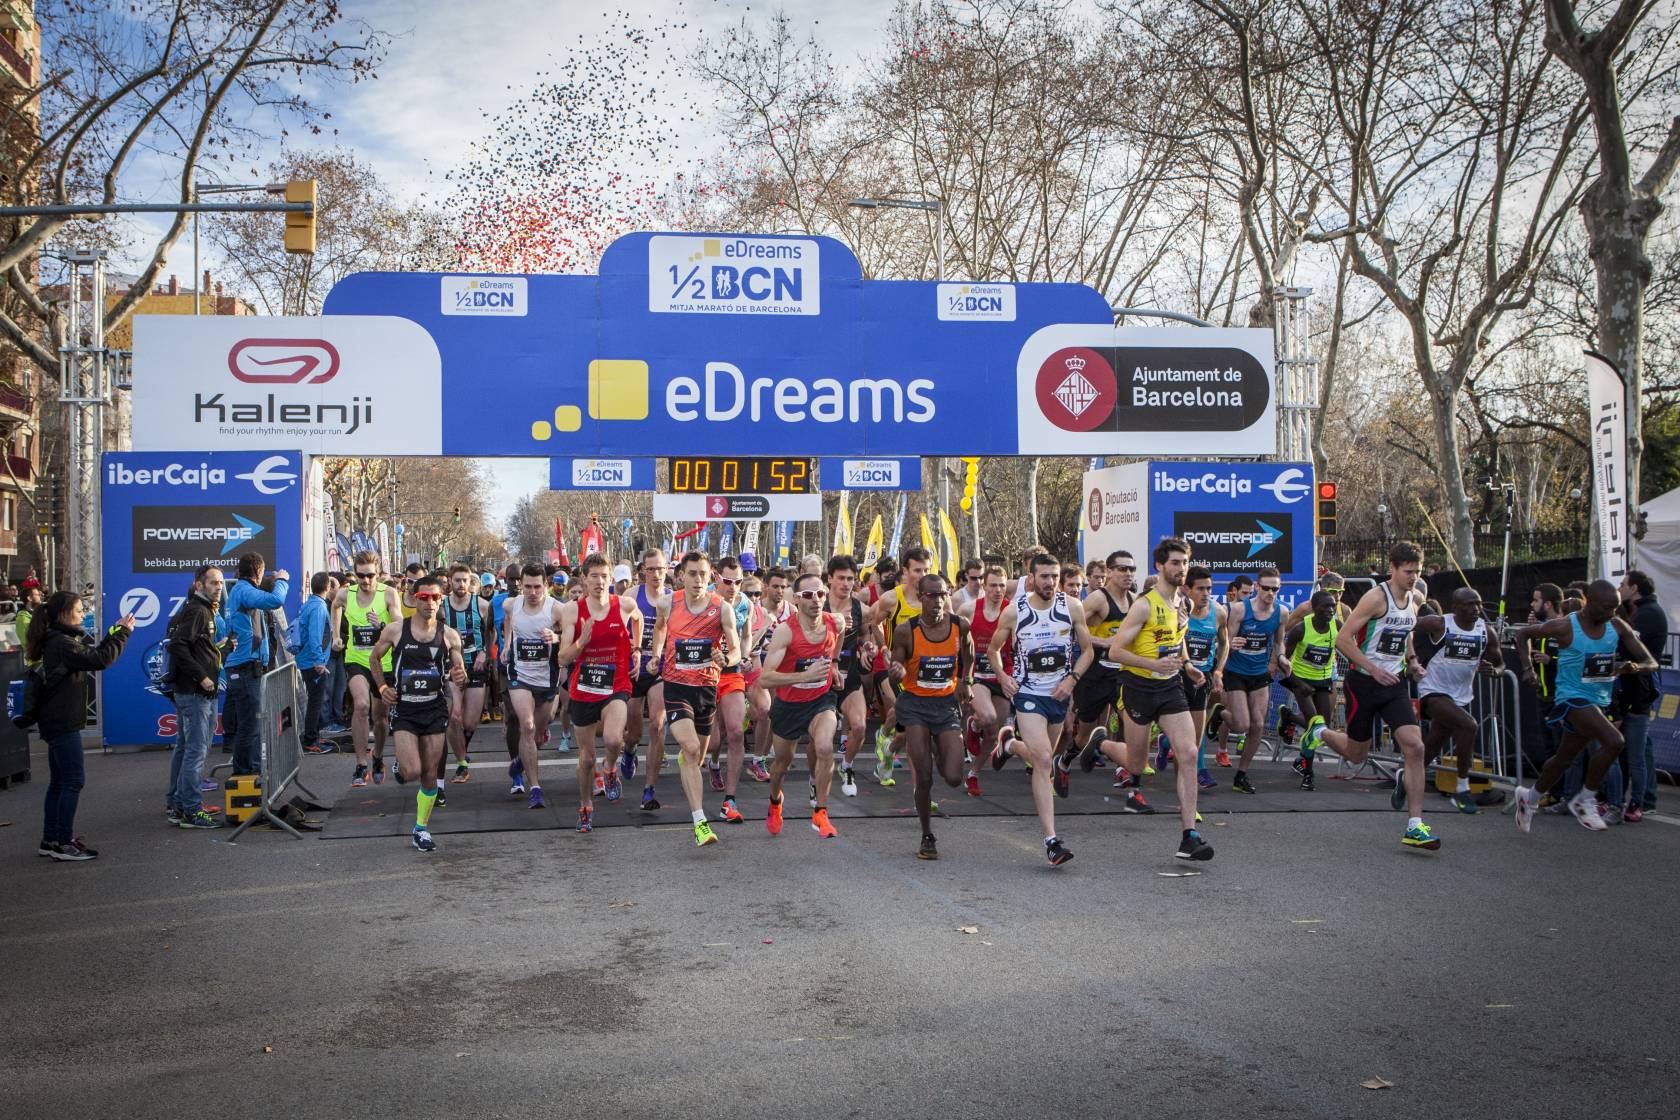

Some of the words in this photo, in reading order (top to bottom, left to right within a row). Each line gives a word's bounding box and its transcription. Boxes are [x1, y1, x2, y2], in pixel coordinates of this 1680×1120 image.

[724, 240, 802, 259] eDreams
[479, 280, 514, 289] eDreams
[711, 265, 803, 302] BCN
[970, 286, 1002, 294] eDreams
[473, 291, 514, 308] BCN
[965, 296, 1002, 312] BCN
[669, 304, 695, 312] MITJA
[696, 304, 734, 312] MARATÓ
[735, 305, 748, 313] DE
[750, 306, 802, 314] BARCELONA
[1132, 366, 1220, 385] Ajuntament
[1223, 367, 1242, 382] de
[665, 361, 936, 423] eDreams
[1132, 386, 1243, 407] Barcelona
[194, 393, 372, 435] Kalenji
[219, 426, 235, 435] find
[236, 428, 254, 436] your
[255, 426, 284, 436] rhythm
[286, 427, 308, 436] enjoy
[309, 428, 327, 436] your
[108, 462, 226, 490] iberCaja
[592, 469, 623, 481] BCN
[673, 460, 710, 491] 00
[770, 460, 806, 491] 52
[862, 470, 892, 482] BCN
[1154, 471, 1252, 498] iberCaja
[1105, 488, 1138, 507] Diputació
[1105, 510, 1140, 525] Barcelona
[143, 527, 252, 541] POWERADE
[1183, 532, 1273, 544] POWERADE
[144, 558, 177, 568] bebida
[180, 559, 200, 568] para
[203, 557, 240, 567] deporti
[1213, 561, 1230, 570] para
[1232, 560, 1276, 570] deportistas
[688, 651, 700, 659] 49
[1193, 648, 1199, 656] 3
[1457, 647, 1470, 655] 58
[1040, 656, 1055, 666] 98
[414, 680, 427, 689] 92
[591, 675, 602, 683] 14
